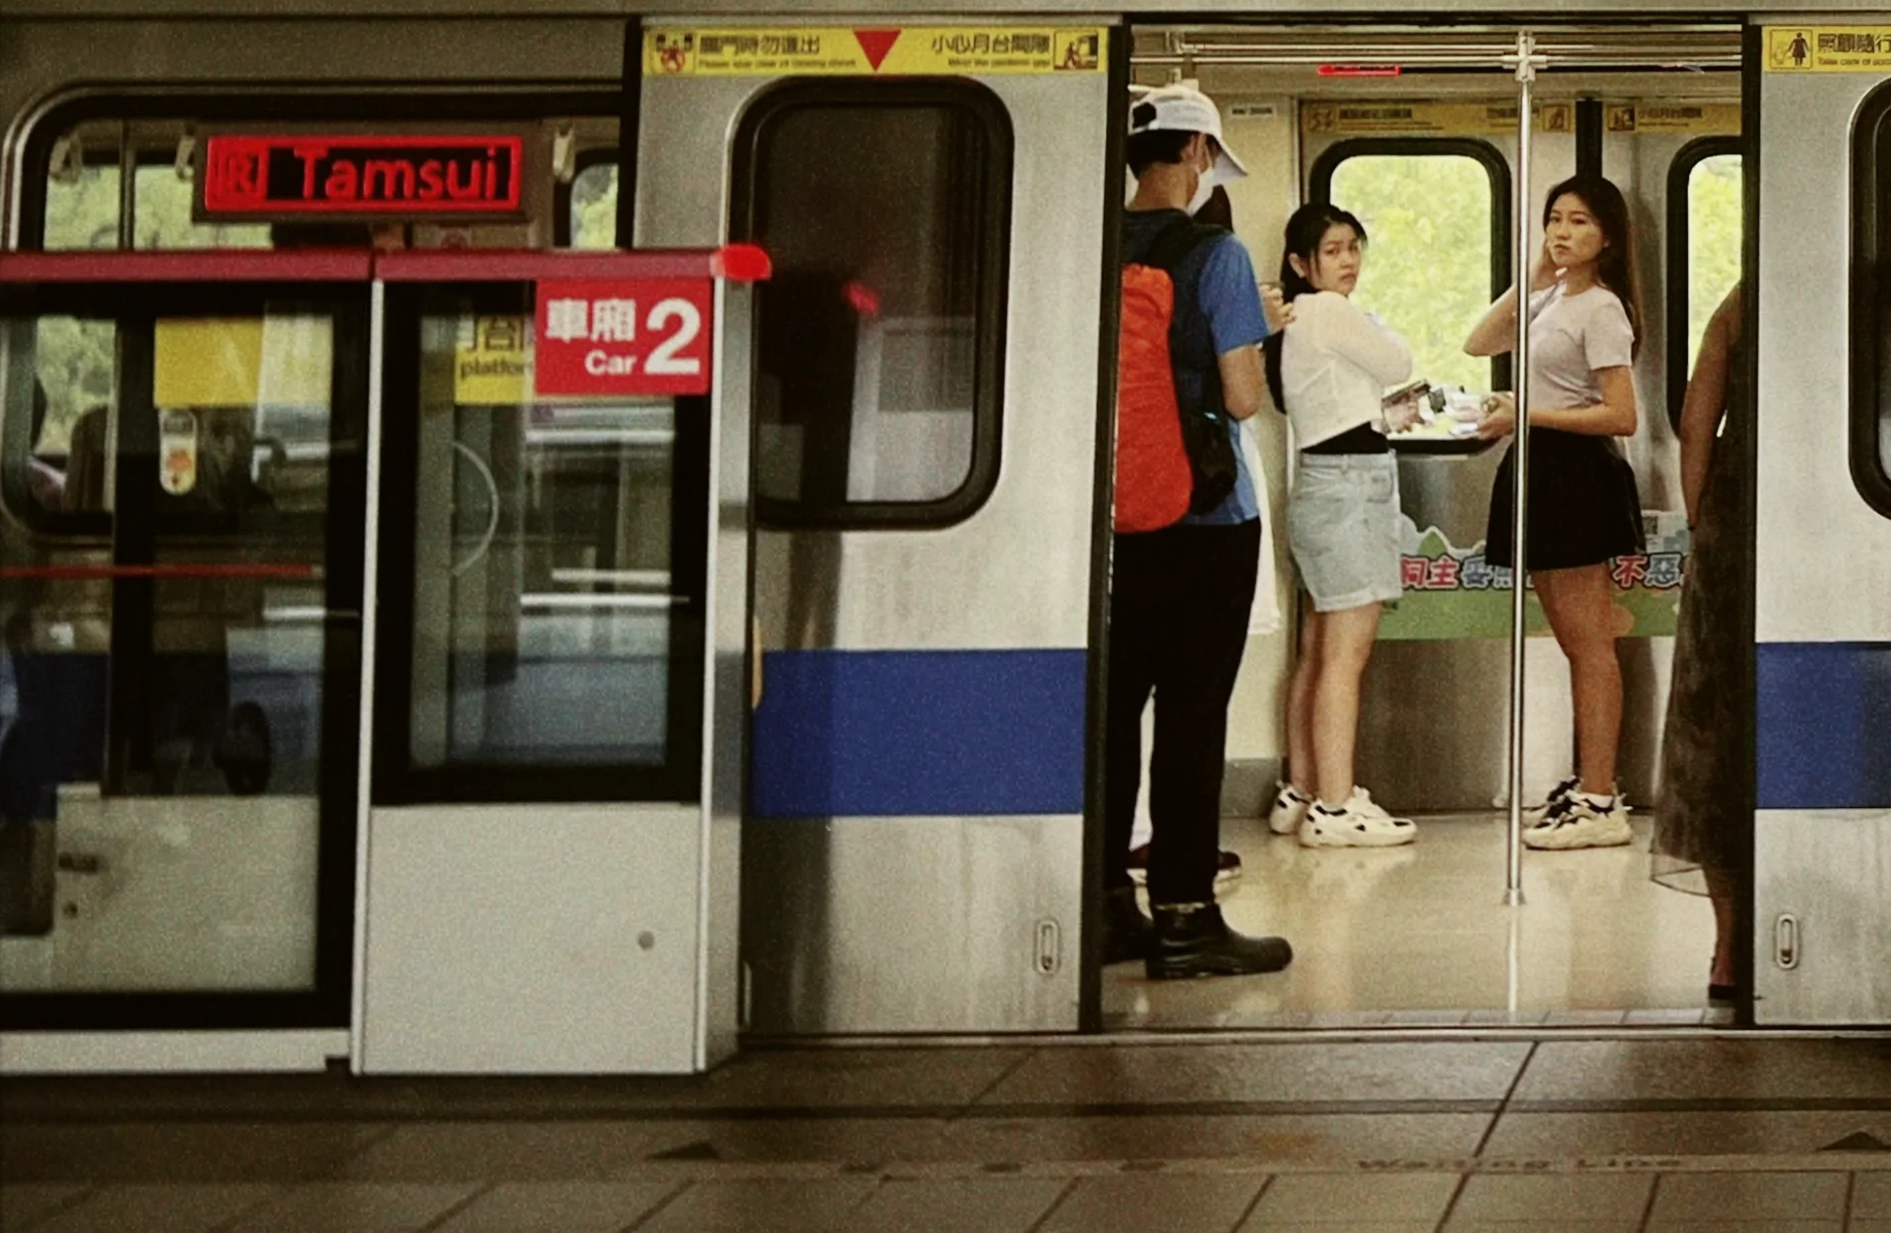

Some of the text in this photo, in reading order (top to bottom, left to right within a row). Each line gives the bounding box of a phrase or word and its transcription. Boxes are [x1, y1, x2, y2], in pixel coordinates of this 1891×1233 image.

[293, 146, 497, 200] Tamsui
[642, 296, 701, 375] 2
[584, 349, 638, 377] Car
